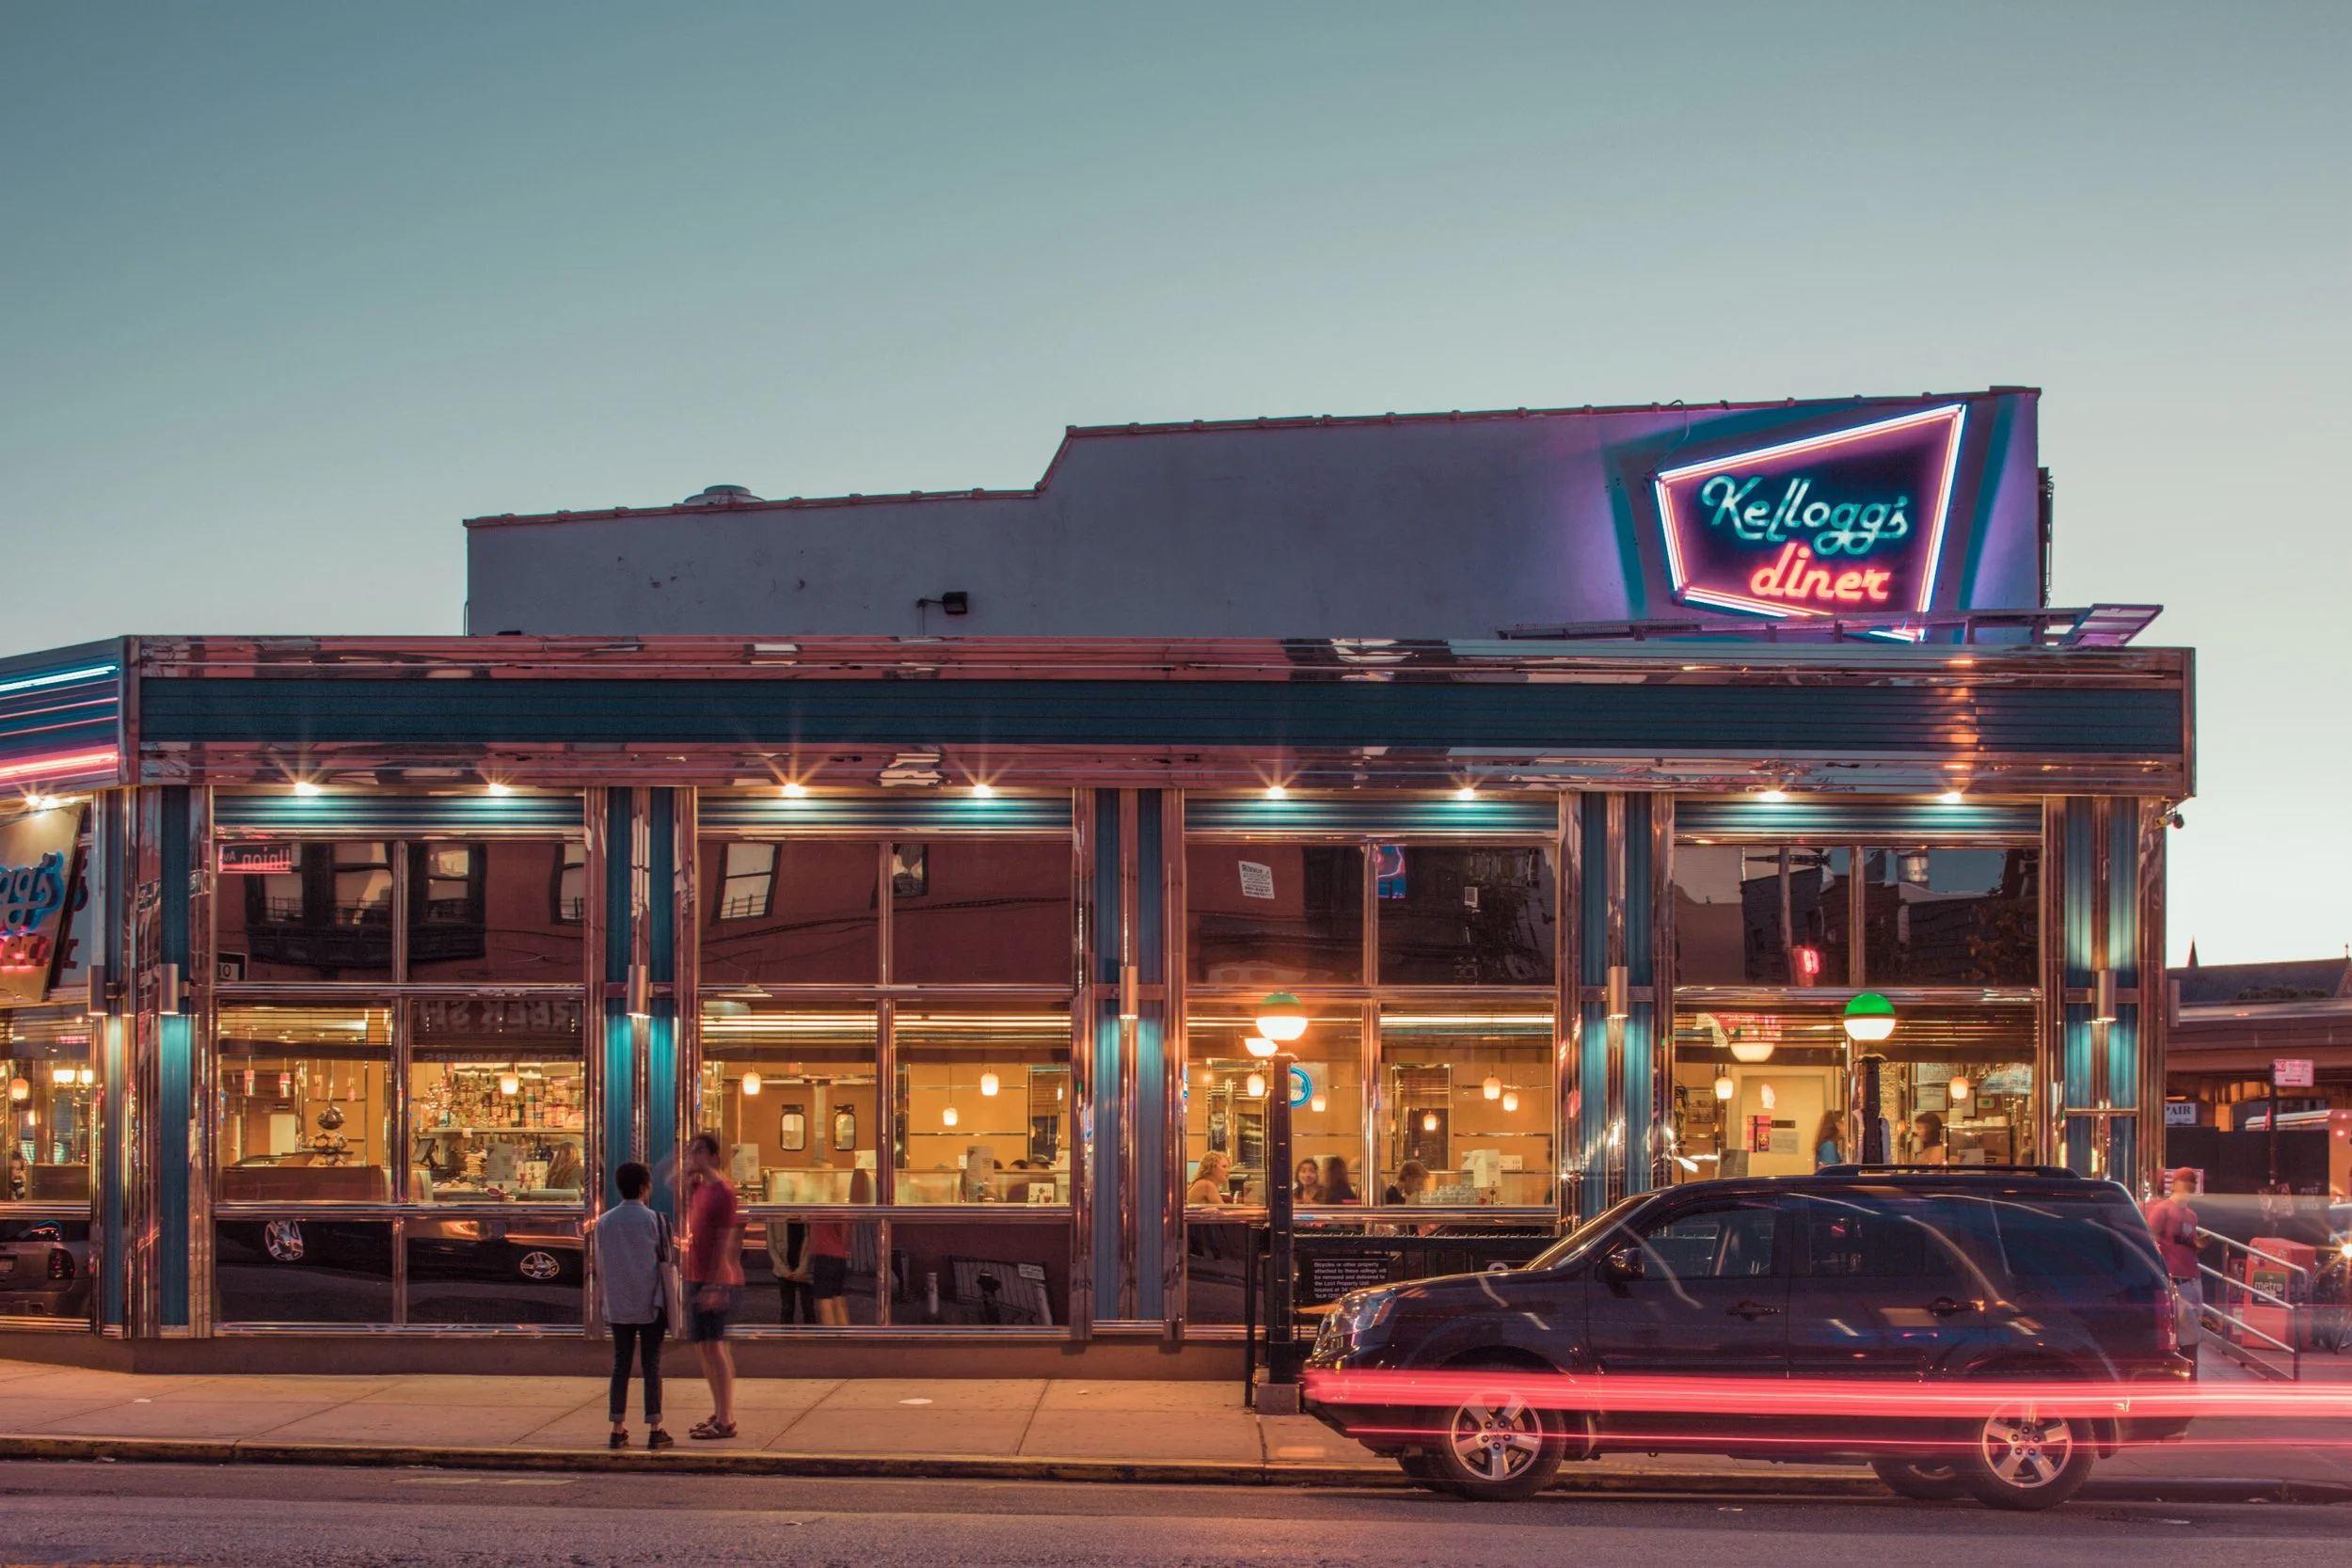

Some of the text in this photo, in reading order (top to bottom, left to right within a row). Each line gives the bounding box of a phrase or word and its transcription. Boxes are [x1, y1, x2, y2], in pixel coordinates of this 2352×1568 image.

[1701, 475, 1908, 556] Kellogg's
[1750, 543, 1891, 600] diner
[2254, 1282, 2283, 1292] metro
